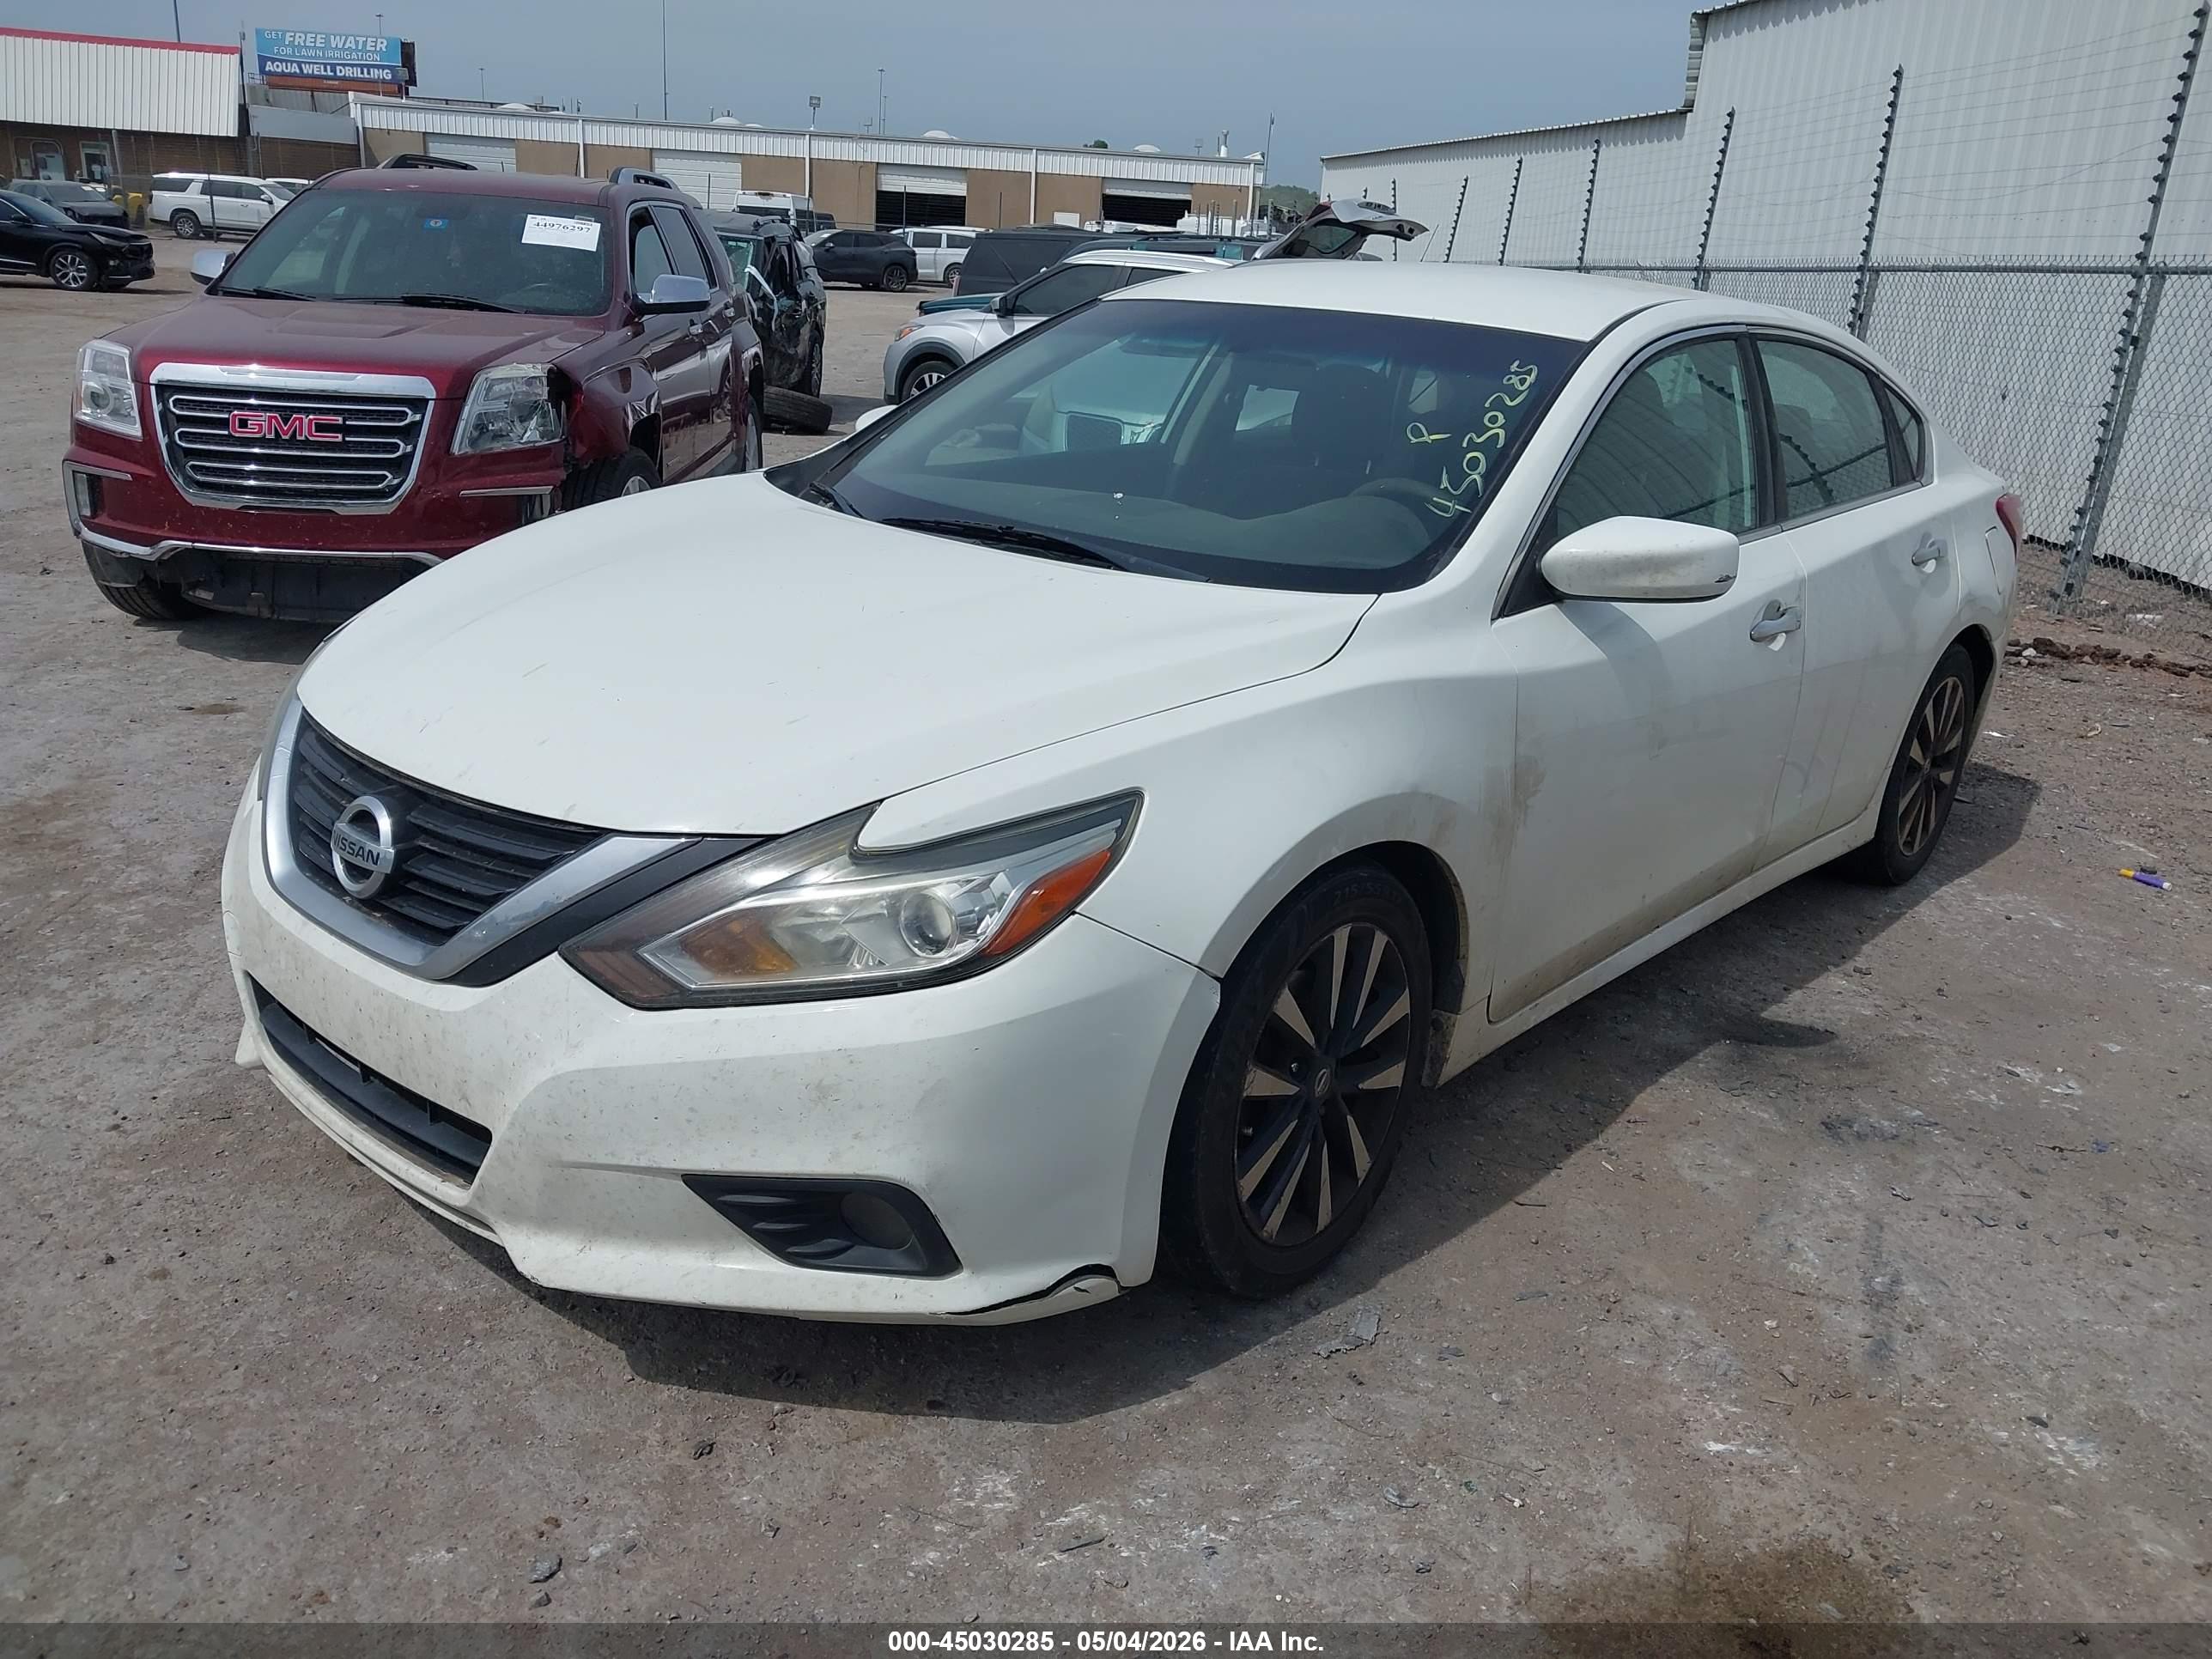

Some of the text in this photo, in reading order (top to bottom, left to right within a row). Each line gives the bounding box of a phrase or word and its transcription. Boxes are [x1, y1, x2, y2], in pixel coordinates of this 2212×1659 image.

[264, 31, 387, 52] GET FREE WATER
[274, 46, 380, 62] FOR LAWN IRRIGATION
[264, 61, 392, 80] AQUA WELL DRILLING
[533, 222, 591, 234] 44976297
[229, 411, 343, 442] GMC
[1424, 359, 1539, 518] 45030285
[333, 829, 380, 866] NISSAN
